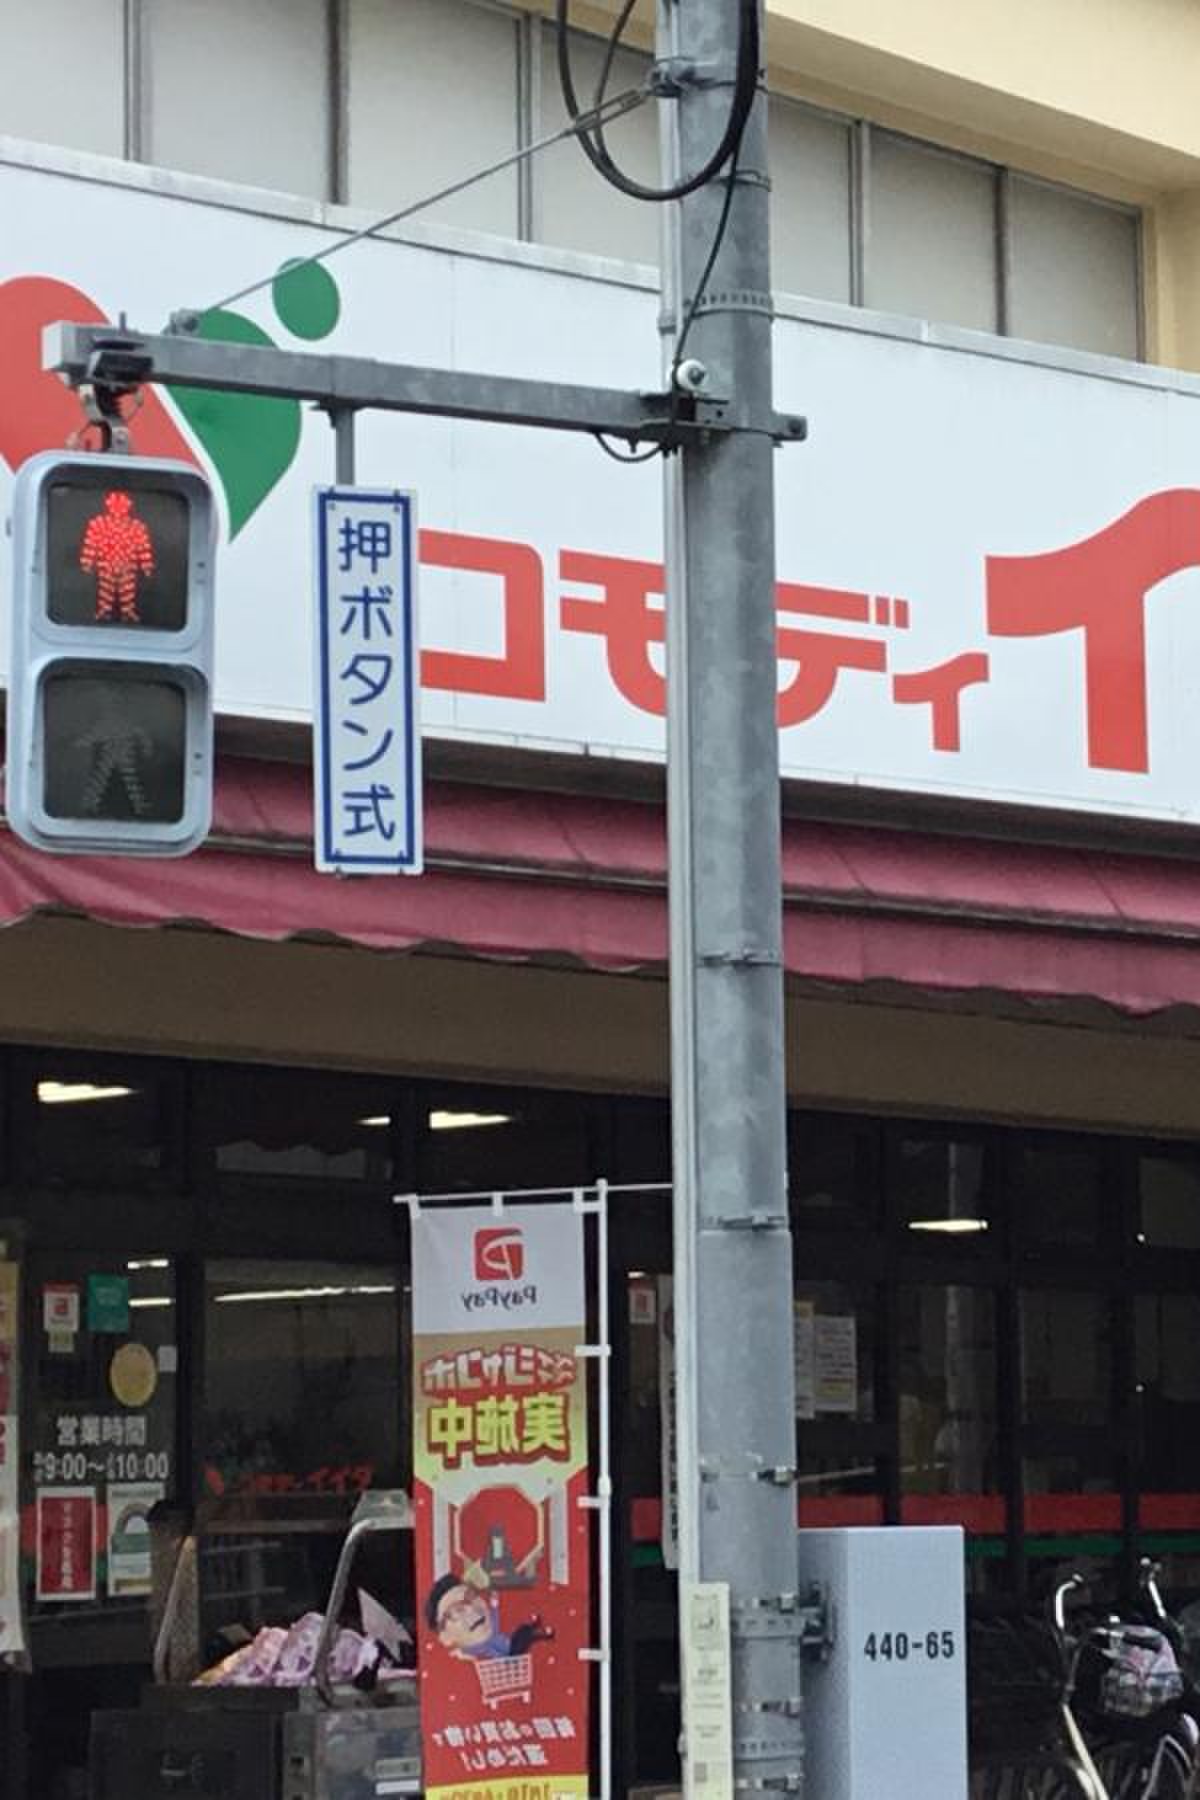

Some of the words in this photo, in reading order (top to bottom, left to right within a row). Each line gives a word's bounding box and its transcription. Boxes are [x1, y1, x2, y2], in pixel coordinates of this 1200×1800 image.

[337, 517, 396, 842] 押ボタン式
[56, 1415, 147, 1447] 営業時間
[863, 1630, 955, 1662] 440-65
